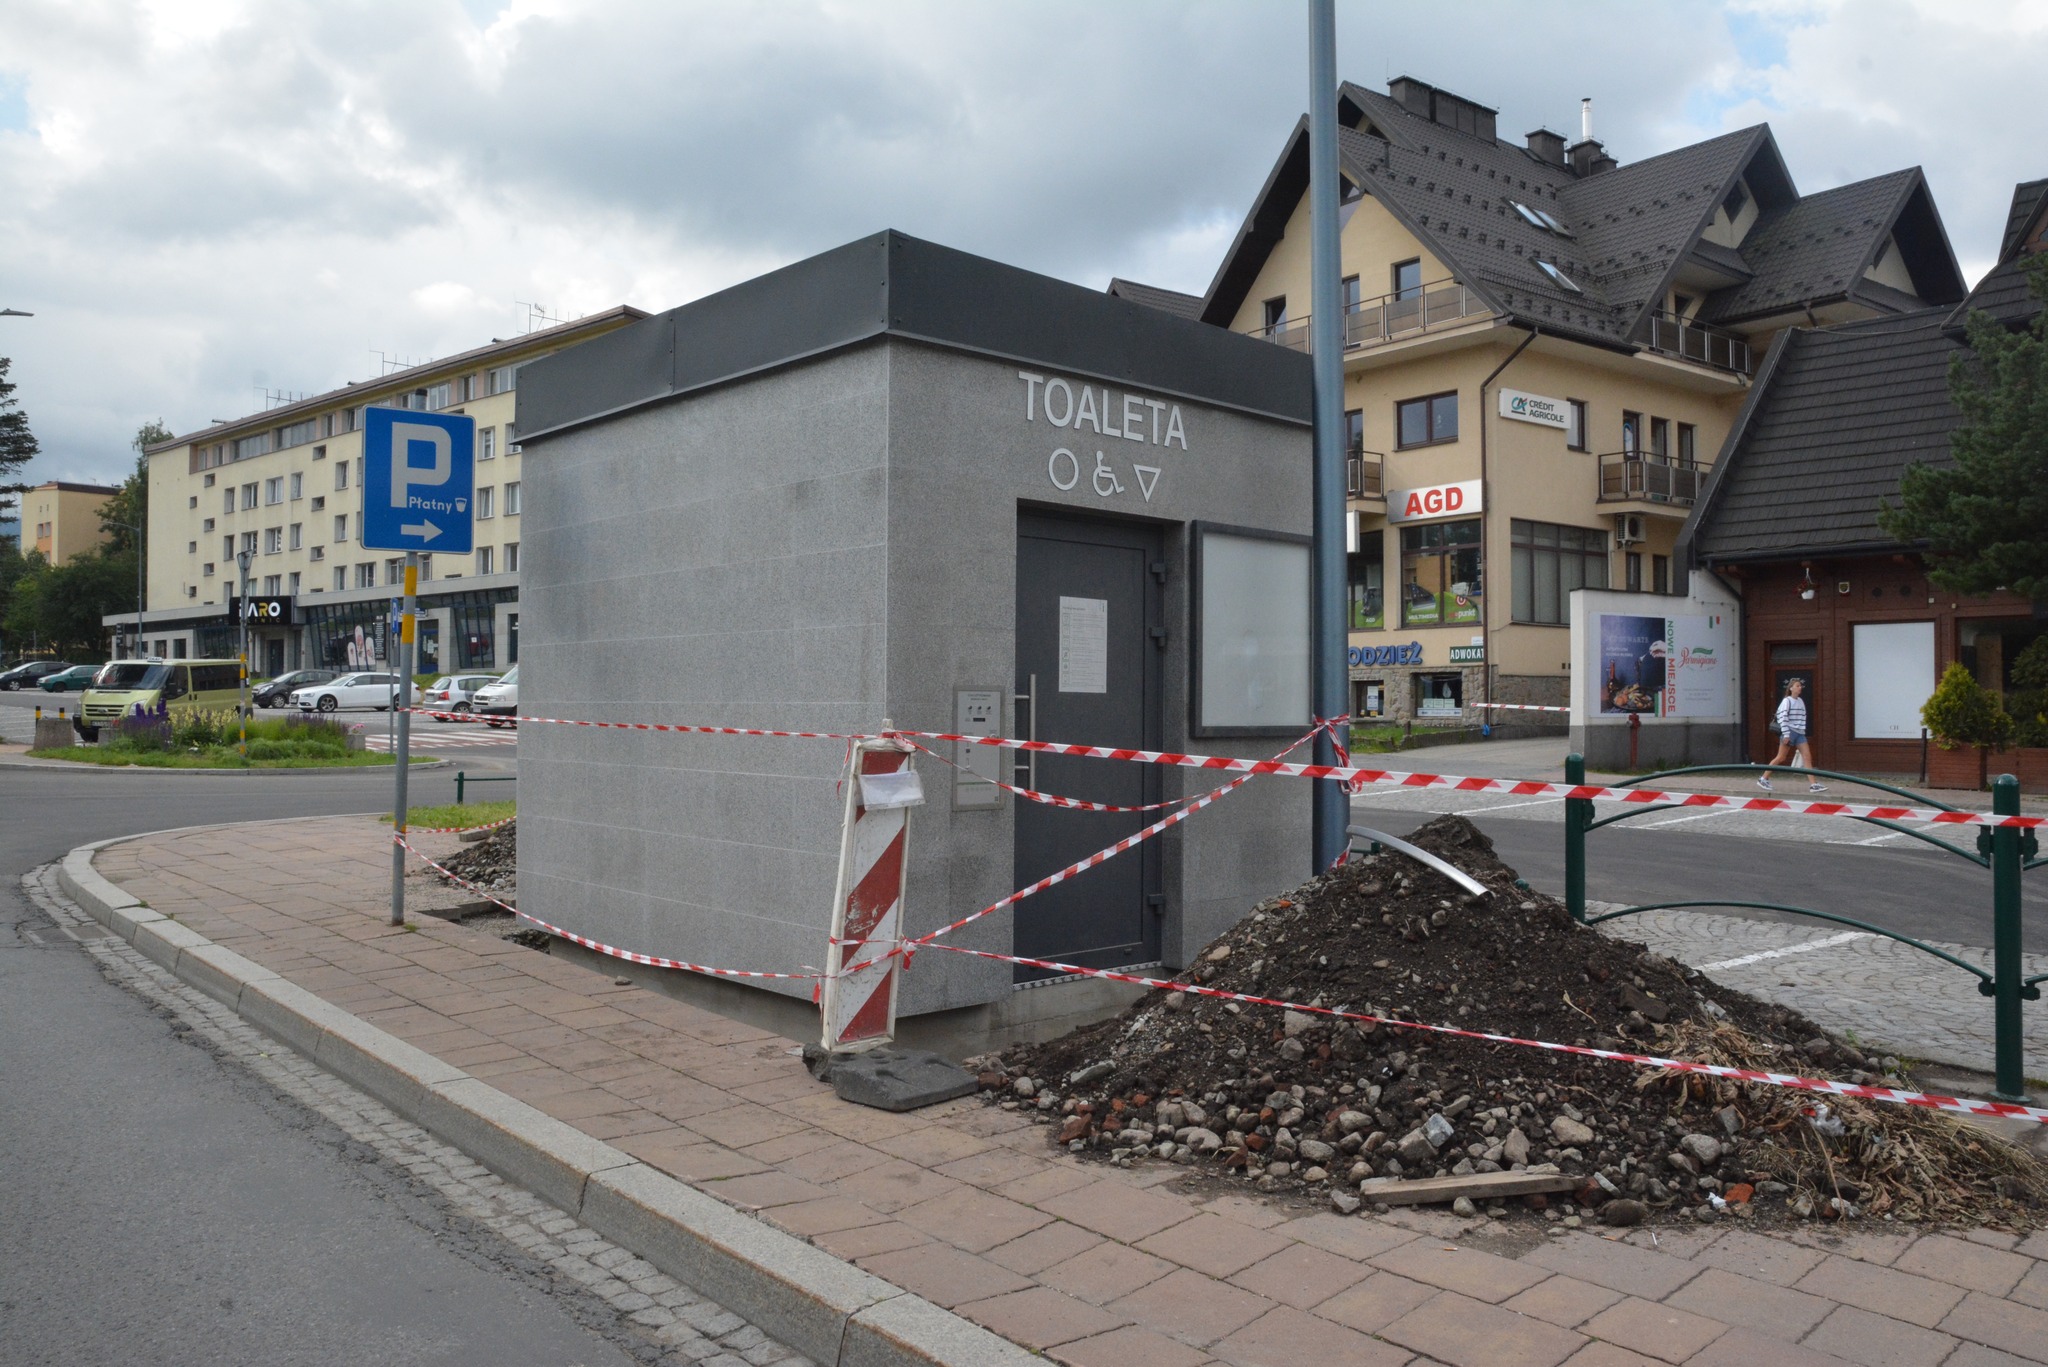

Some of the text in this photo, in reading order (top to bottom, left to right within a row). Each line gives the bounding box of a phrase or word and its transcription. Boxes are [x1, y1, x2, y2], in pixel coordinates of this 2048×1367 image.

[1018, 371, 1188, 450] TOALETA
[1529, 399, 1555, 412] CRÉDIT
[1529, 409, 1565, 423] AGRICOLE
[391, 422, 452, 508] P
[408, 496, 453, 514] Płatny
[1404, 487, 1463, 517] AGD
[239, 602, 281, 617] ARO
[1348, 641, 1423, 667] ODZIEŻ
[1450, 648, 1484, 660] ADWOKAT
[1667, 620, 1676, 713] NOWE MIEJSCE
